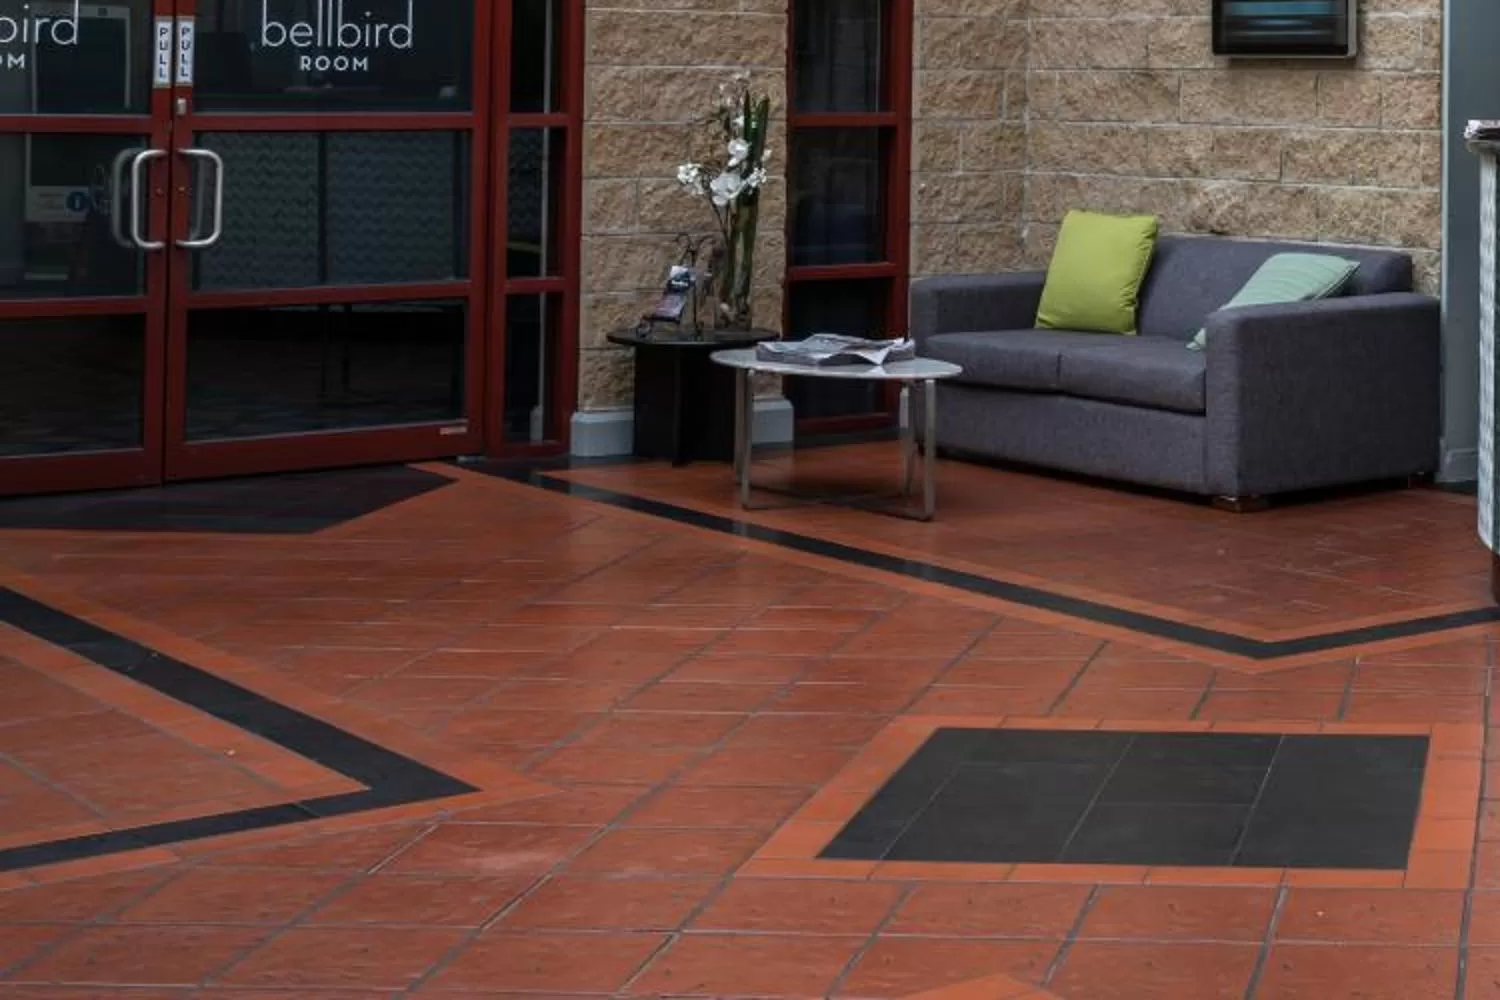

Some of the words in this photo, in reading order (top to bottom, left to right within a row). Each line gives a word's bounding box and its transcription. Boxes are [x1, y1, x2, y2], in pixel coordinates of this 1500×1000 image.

[158, 26, 169, 79] PULL
[180, 26, 192, 78] PULL
[300, 55, 369, 71] ROOM
